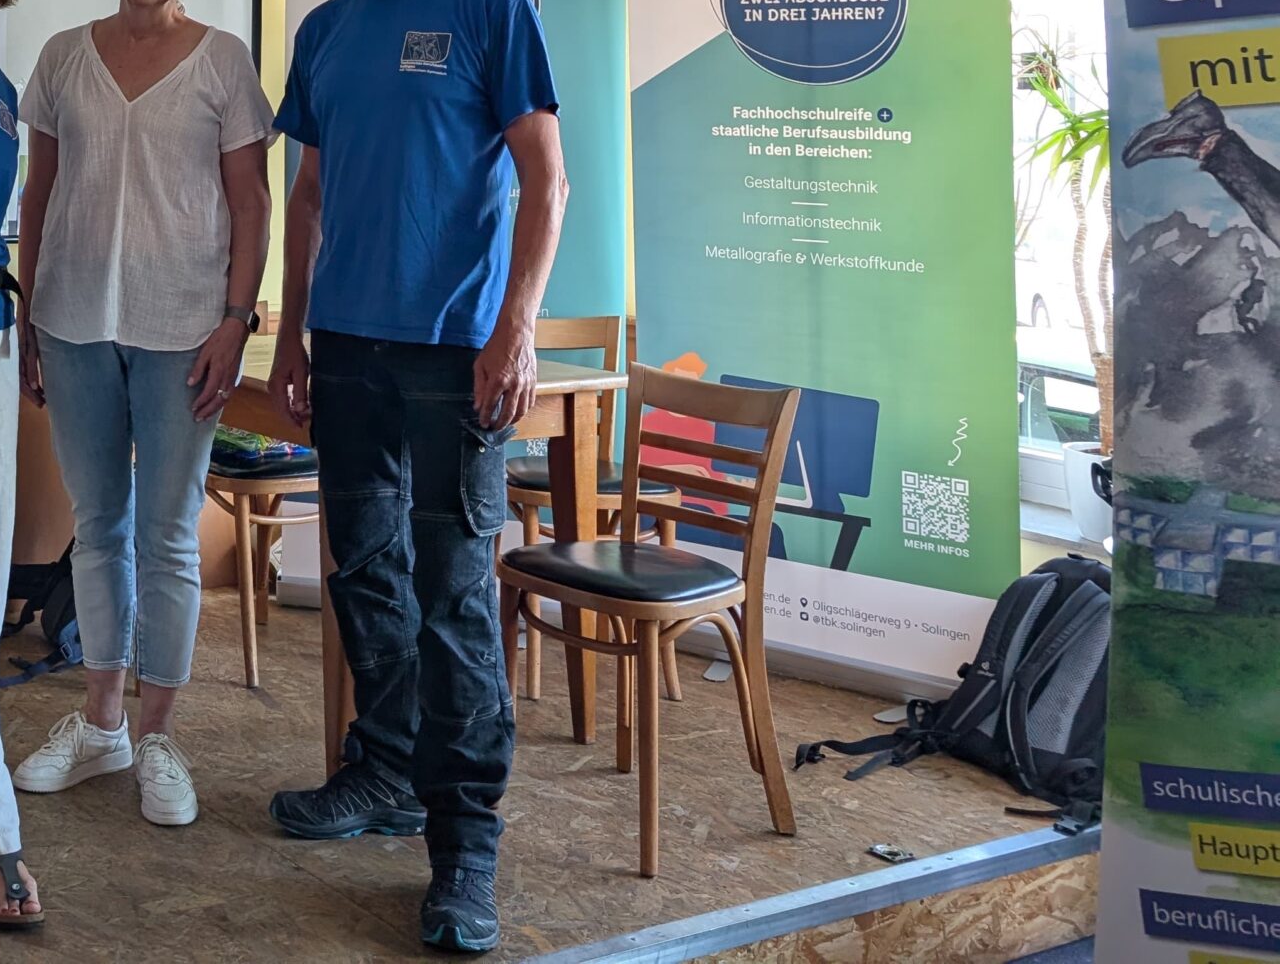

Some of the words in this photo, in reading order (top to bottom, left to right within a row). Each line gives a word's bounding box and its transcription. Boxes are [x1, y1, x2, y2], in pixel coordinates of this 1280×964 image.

[744, 9, 762, 22] IN
[768, 8, 806, 21] DREI
[811, 6, 885, 21] JAHREN?
[1189, 46, 1276, 87] mit
[733, 106, 872, 121] Fachhochschulreife
[711, 125, 779, 138] staatliche
[783, 126, 912, 143] Berufsausbildung
[749, 143, 762, 155] in
[765, 144, 791, 156] den
[795, 145, 872, 159] Bereichen:
[744, 176, 878, 194] Gestaltungstechnik
[742, 211, 882, 232] Informationstechnik
[705, 245, 792, 263] Metallografie
[796, 252, 807, 263] &
[810, 252, 925, 273] Werkstoffkunde
[904, 539, 935, 553] MEHR
[937, 545, 970, 558] INFOS
[812, 614, 886, 638] @tbk.solingen
[904, 619, 911, 628] 9
[922, 623, 970, 641] Solingen
[1153, 778, 1280, 807] schulische
[1153, 902, 1280, 938] berufliche
